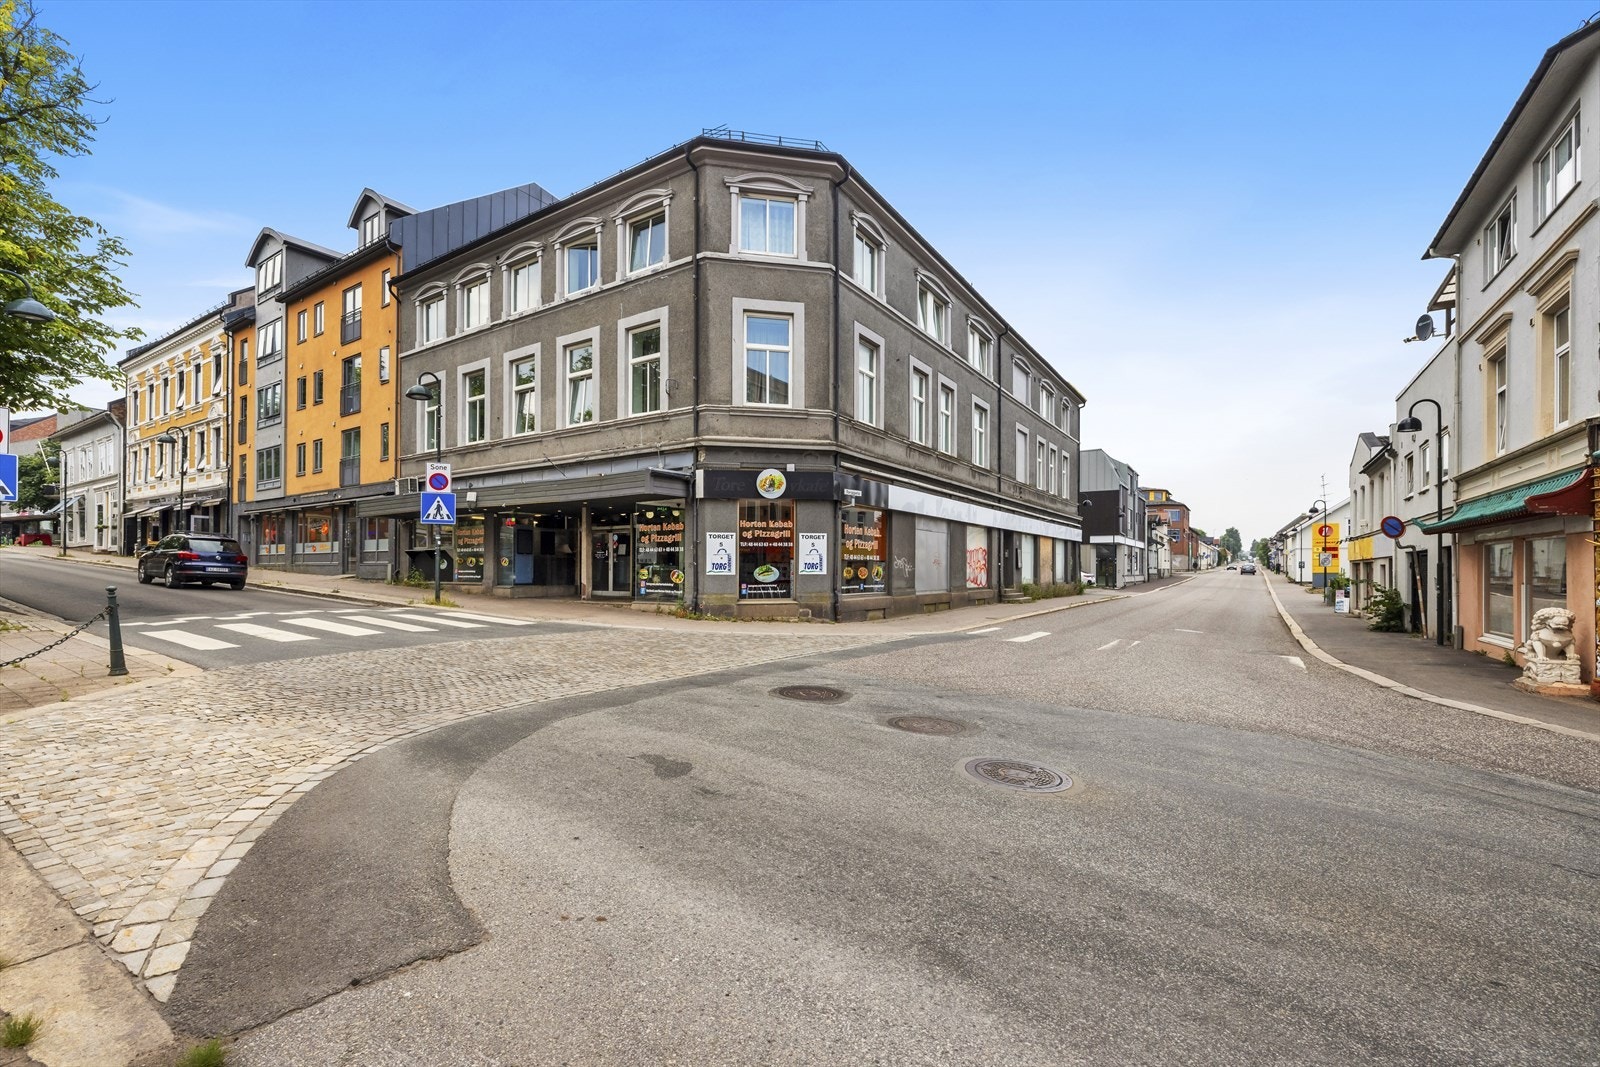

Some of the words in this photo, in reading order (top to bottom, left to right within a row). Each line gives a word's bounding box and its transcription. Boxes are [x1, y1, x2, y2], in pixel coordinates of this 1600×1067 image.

[662, 522, 684, 530] Kebab
[844, 524, 862, 535] Horten
[754, 530, 791, 538] Pizzagrill
[641, 535, 649, 544] og
[846, 540, 853, 550] og
